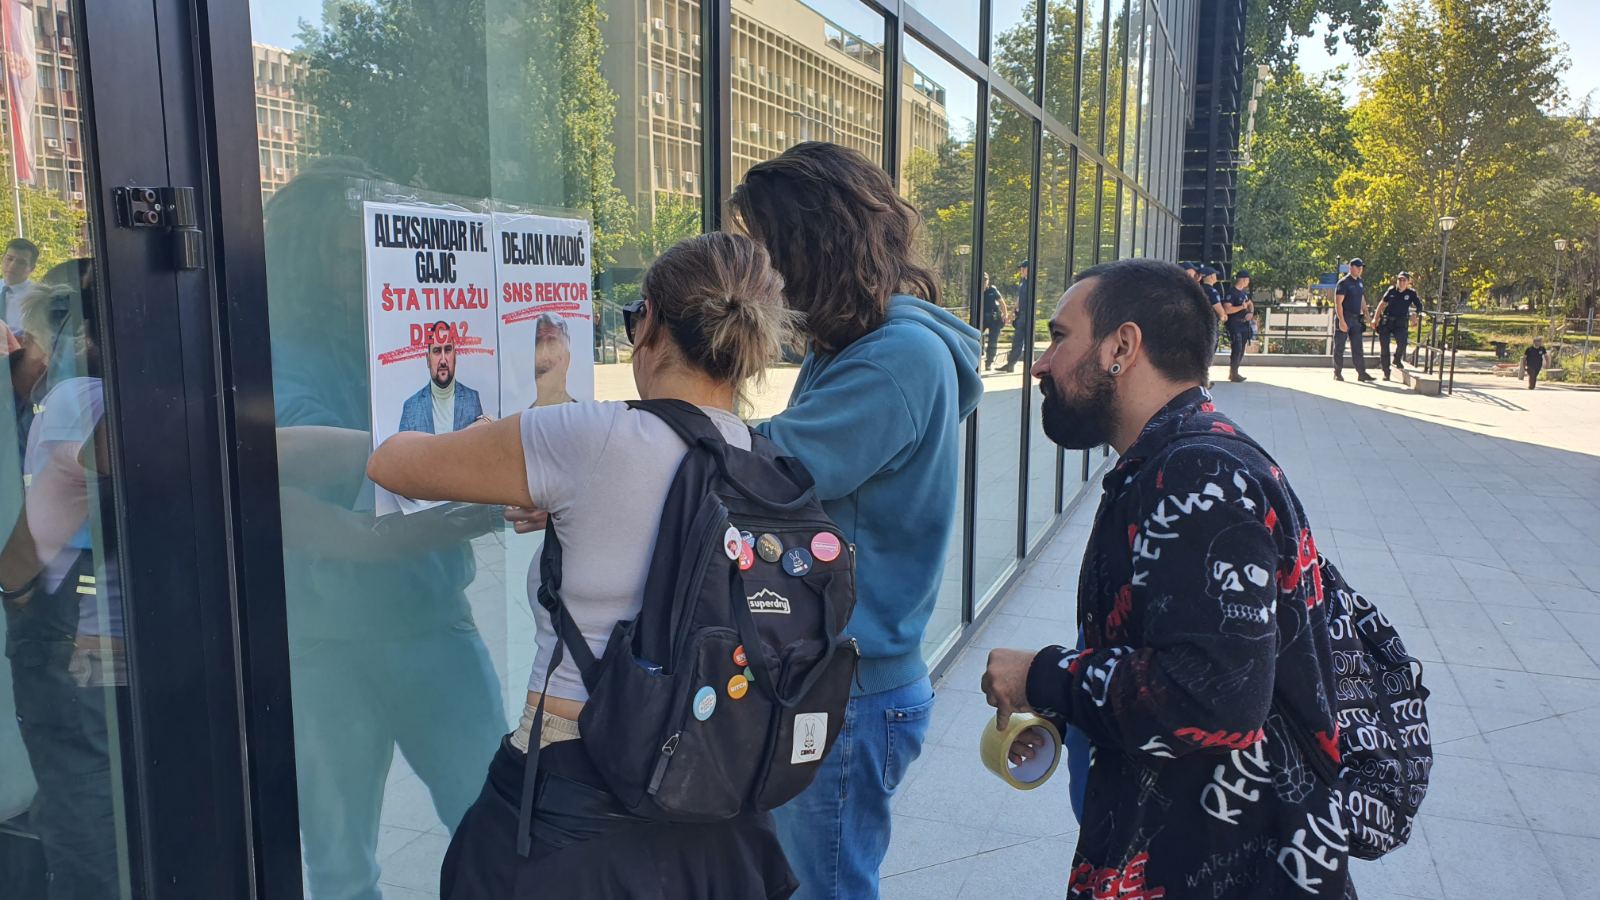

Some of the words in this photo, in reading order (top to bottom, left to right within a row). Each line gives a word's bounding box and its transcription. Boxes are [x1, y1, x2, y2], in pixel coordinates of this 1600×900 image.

[374, 213, 467, 252] ALEKSANDAR
[469, 221, 488, 253] M.
[501, 231, 544, 266] DEJAN
[545, 229, 585, 267] MADIĆ
[381, 283, 421, 312] ŠTA
[421, 288, 441, 311] TI
[443, 283, 489, 310] KAŽU
[502, 282, 533, 303] SNS
[535, 282, 588, 302] REKTOR
[409, 320, 469, 346] DECA?
[749, 598, 788, 611] superdry
